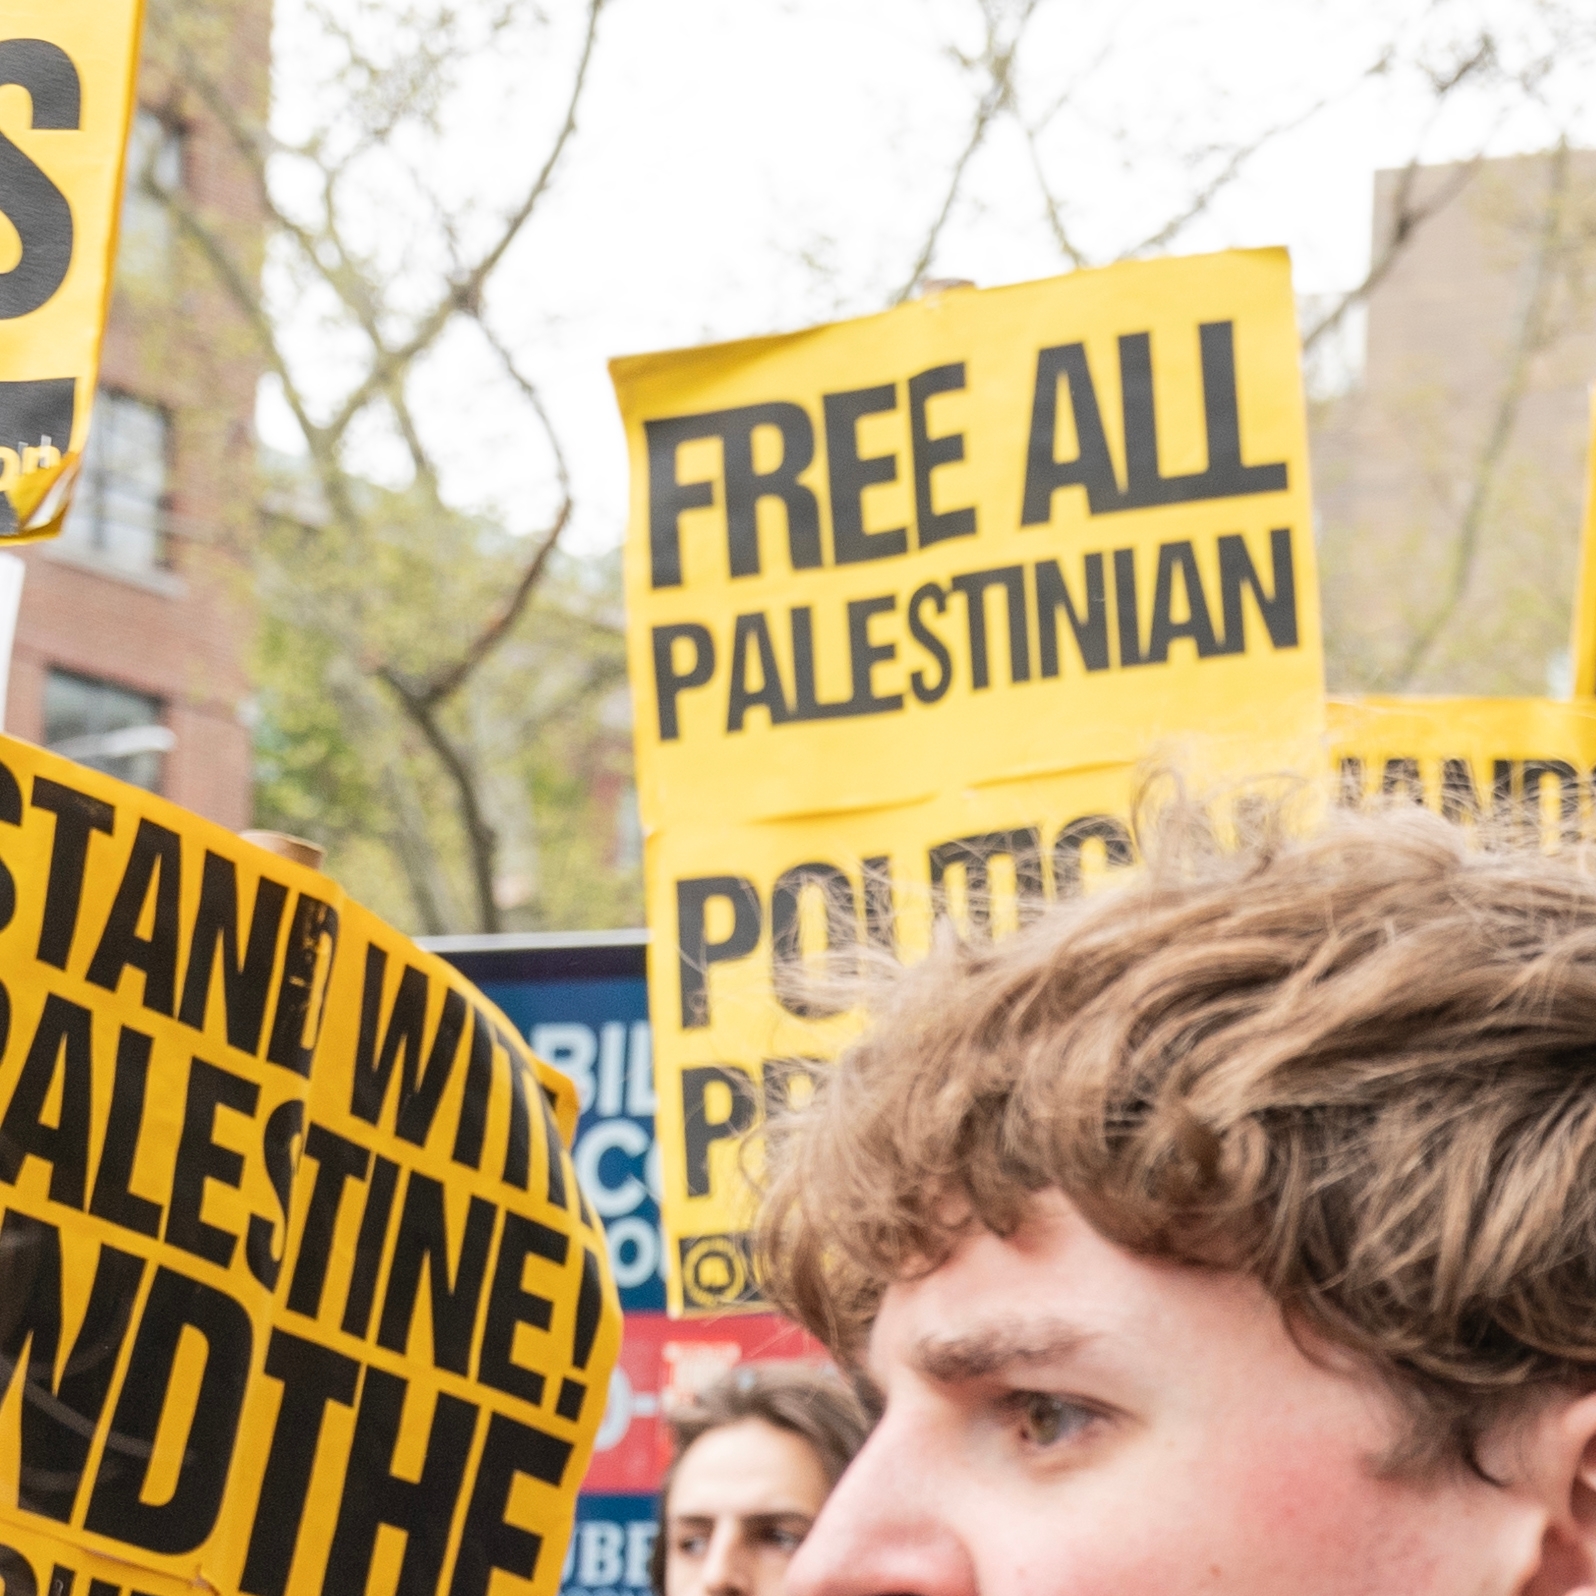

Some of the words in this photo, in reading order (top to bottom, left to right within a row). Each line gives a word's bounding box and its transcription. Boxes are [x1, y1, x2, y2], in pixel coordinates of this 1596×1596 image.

[643, 362, 978, 590] FREE
[1020, 319, 1289, 529] ALL
[652, 527, 1299, 741] PALESTINIAN
[0, 760, 340, 1080] TAND
[0, 976, 605, 1423] ALESTINE!
